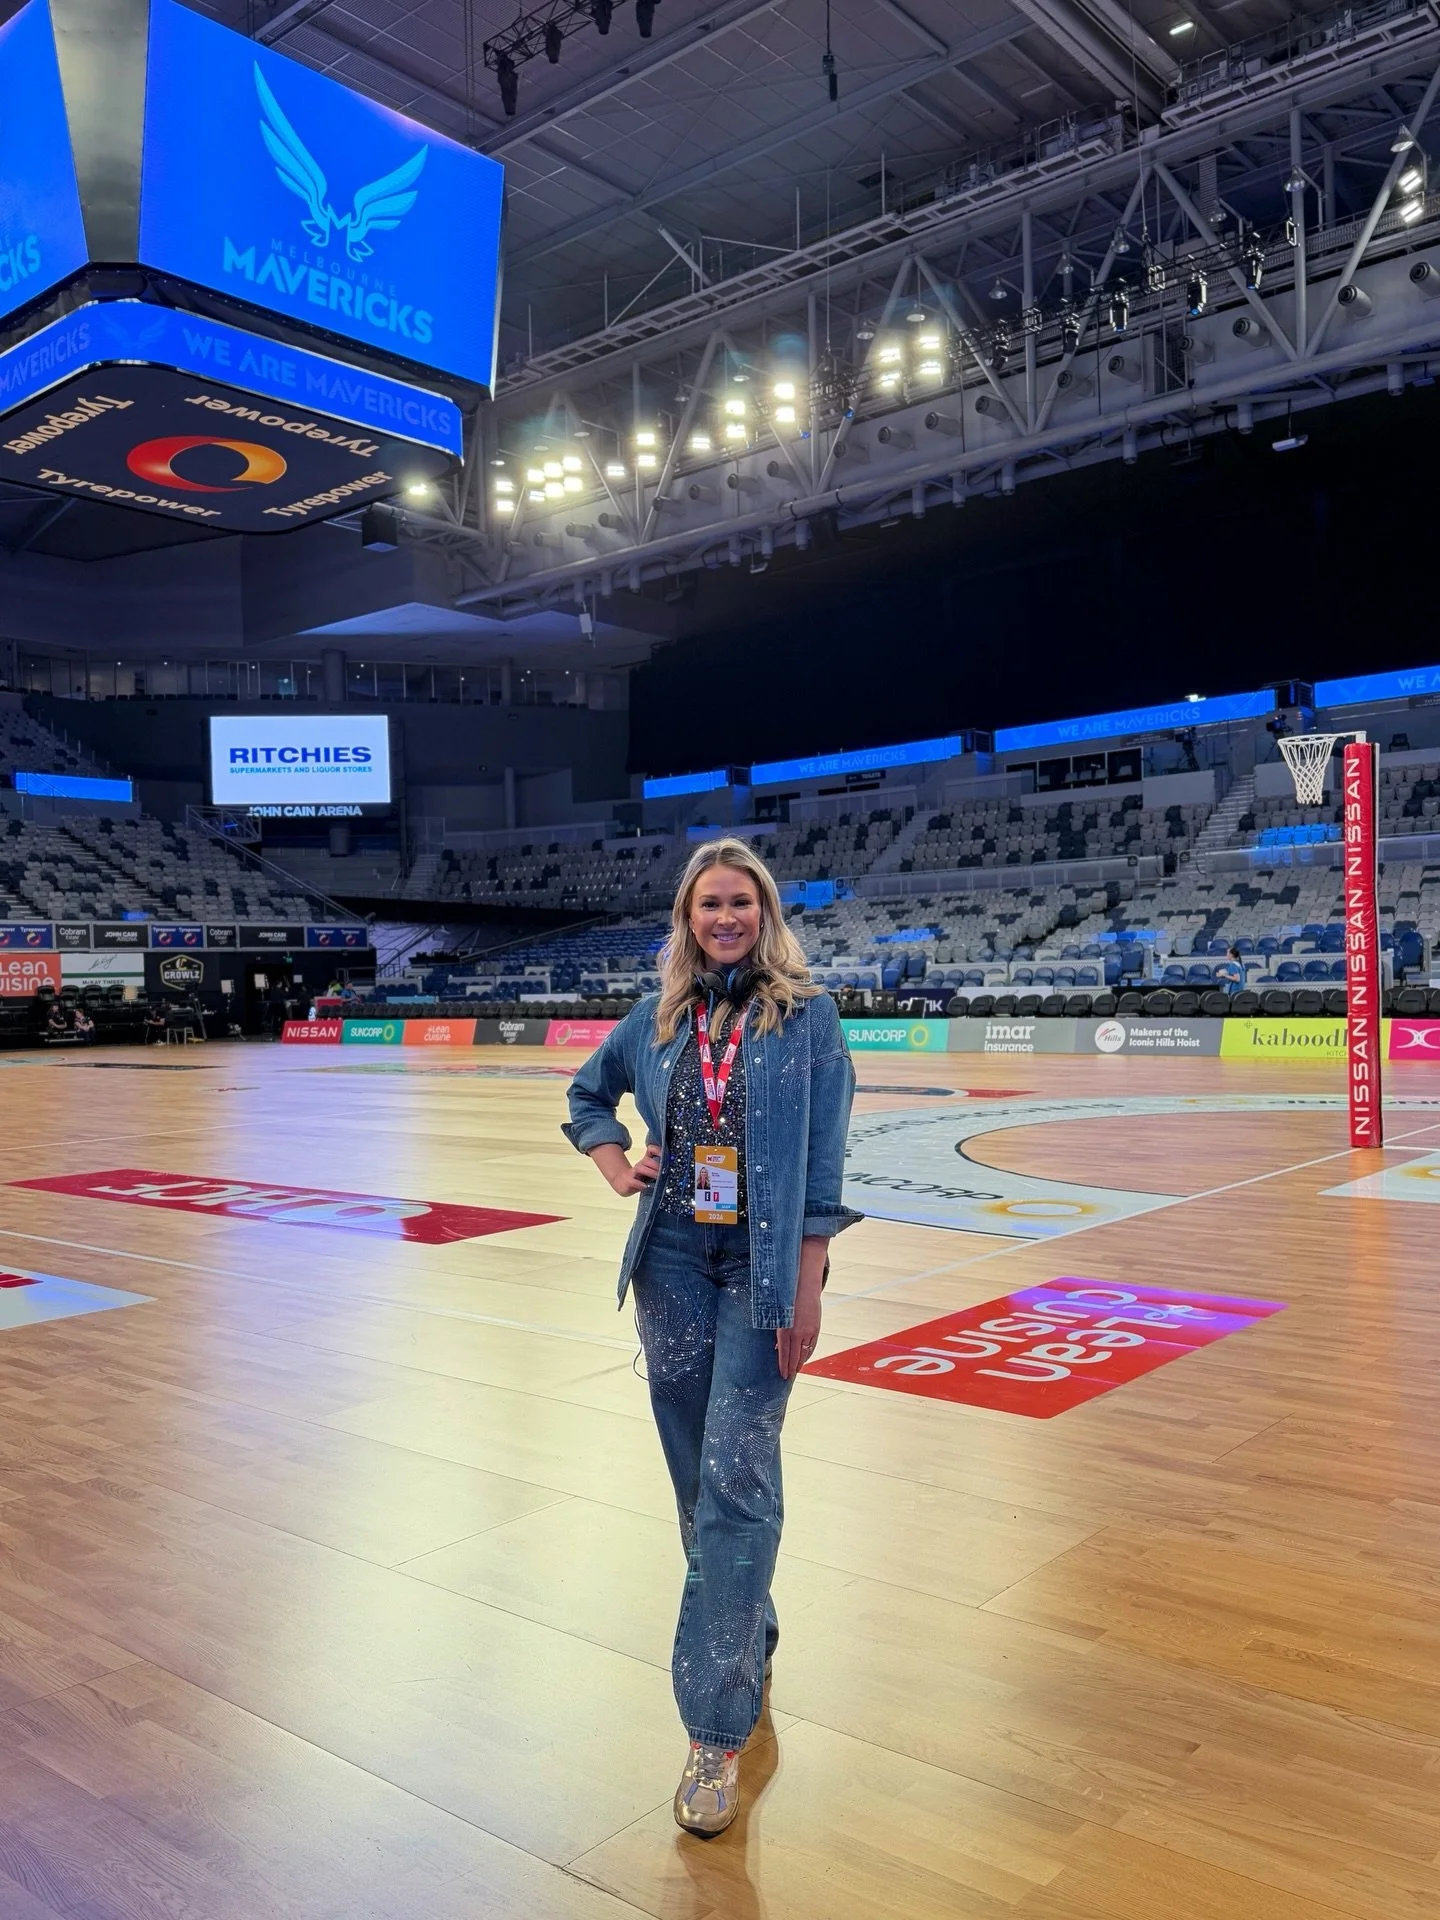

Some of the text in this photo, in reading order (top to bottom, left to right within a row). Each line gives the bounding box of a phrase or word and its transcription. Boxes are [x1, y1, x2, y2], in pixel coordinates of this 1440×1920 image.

[271, 238, 397, 298] MELBOURNE
[223, 236, 434, 344] MAVERICKS
[181, 328, 451, 435] WE ARE MAVERICKS
[2, 395, 135, 455] Tyrepower
[184, 395, 381, 458] Tyrepower
[36, 468, 223, 518] Tyrepower
[262, 470, 393, 518] Tyrepower
[1397, 675, 1427, 690] WE
[1057, 706, 1201, 737] WE ARE MAVERICKS
[229, 746, 372, 764] RITCHIES
[798, 749, 907, 774] WE ARE MAVERICKS
[229, 766, 292, 774] SUPERMARKETS
[343, 765, 372, 773] STORES
[247, 806, 363, 817] JOHN CAIN ARENA
[1346, 757, 1362, 875] NISSAN
[59, 927, 86, 936] Cobram
[209, 928, 233, 937] Cobram
[1348, 889, 1367, 1005] NISSAN
[164, 970, 201, 980] CROWLZ
[287, 1026, 338, 1038] NISSAN
[350, 1026, 383, 1038] SUNCORP
[432, 1025, 450, 1033] Lean
[499, 1020, 525, 1032] Cobram
[848, 1028, 907, 1042] SUNCORP
[984, 1022, 1036, 1040] imar
[1130, 1027, 1189, 1037] Makers of the
[984, 1041, 1034, 1052] insurance
[1104, 1034, 1122, 1042] Hills
[1129, 1037, 1201, 1047] Iconic Hills Hoist
[1252, 1027, 1348, 1048] kaboodl
[1352, 1018, 1370, 1135] NISSAN
[843, 1170, 1005, 1201] NCORP
[975, 1315, 1183, 1383] Lean
